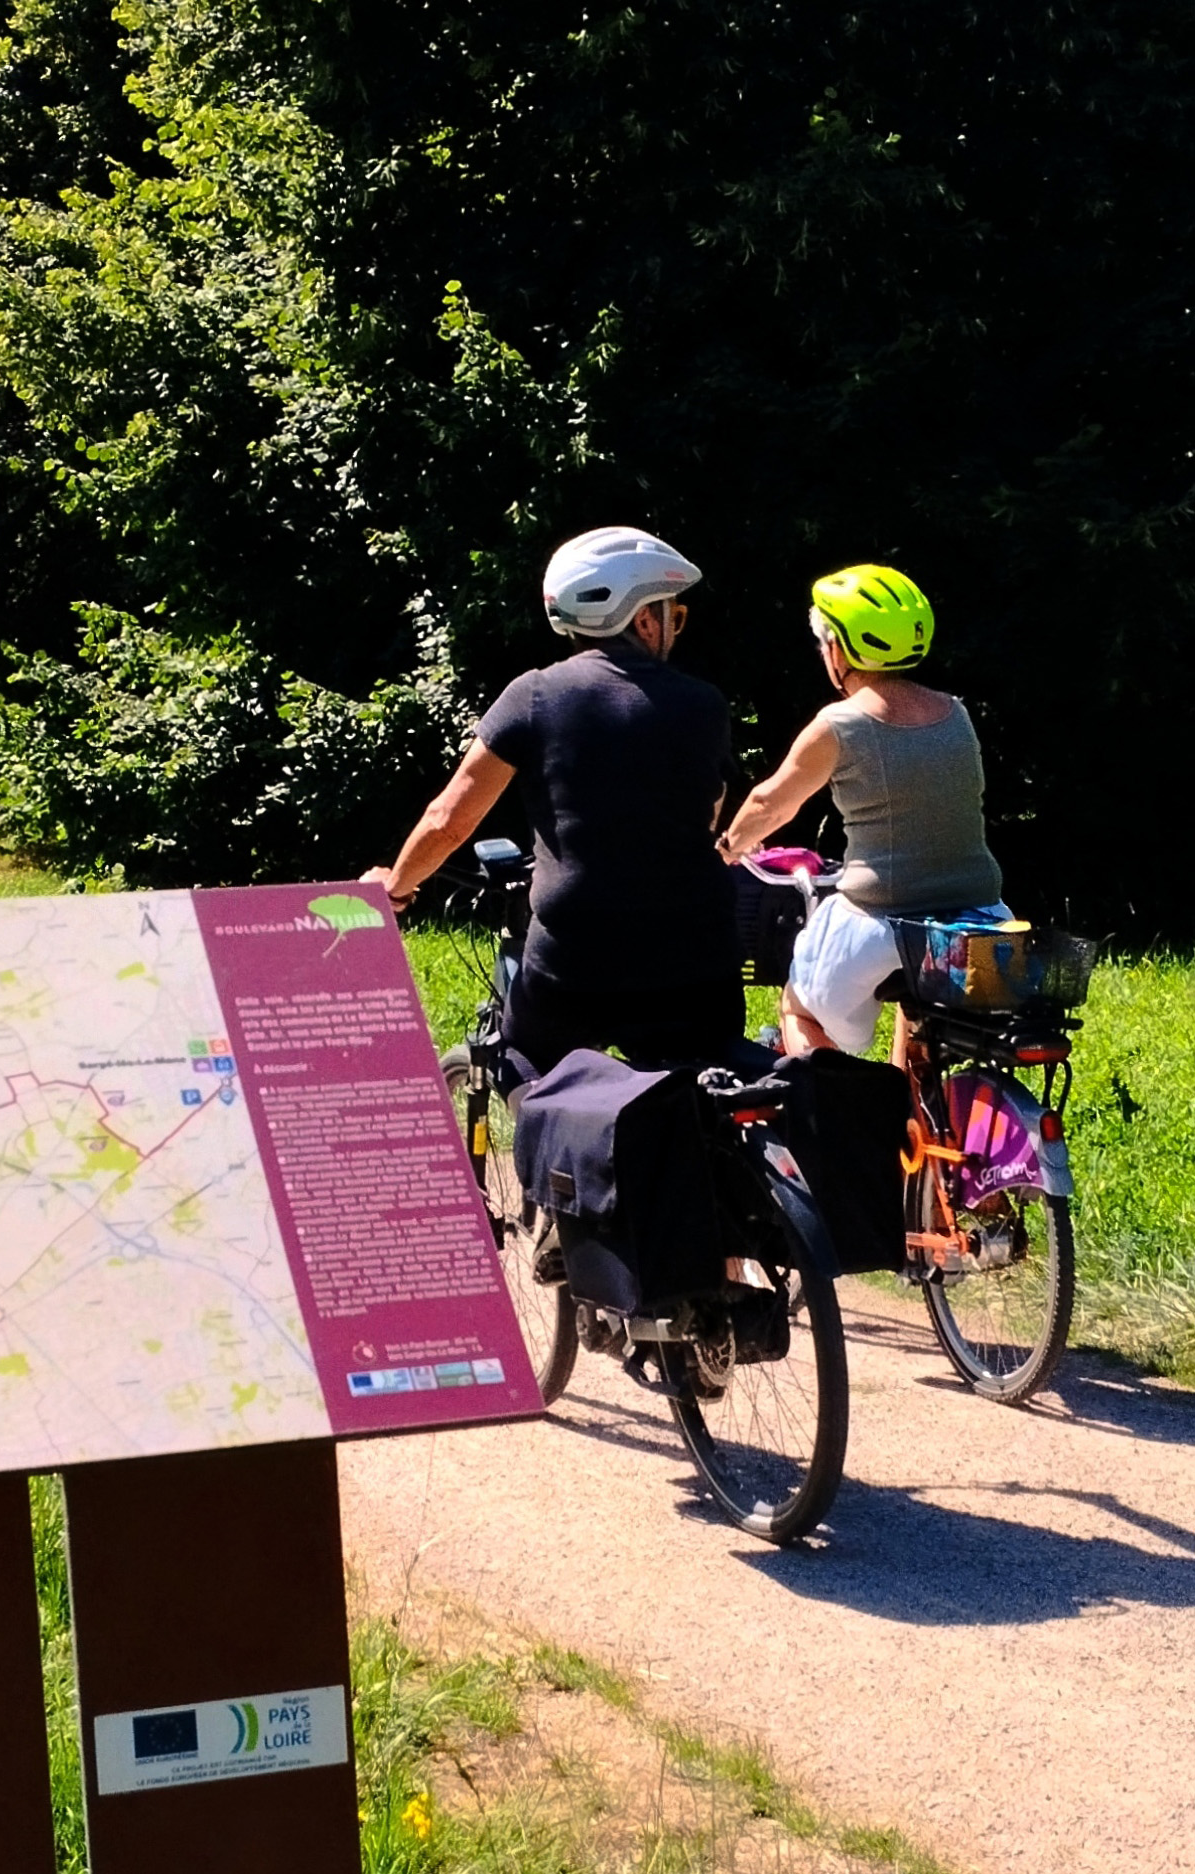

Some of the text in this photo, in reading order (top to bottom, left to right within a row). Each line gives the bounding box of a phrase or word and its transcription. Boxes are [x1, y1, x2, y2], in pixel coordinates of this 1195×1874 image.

[215, 922, 294, 935] BOULEVARD
[268, 1704, 310, 1723] PAYS
[264, 1729, 311, 1750] LOIRE
